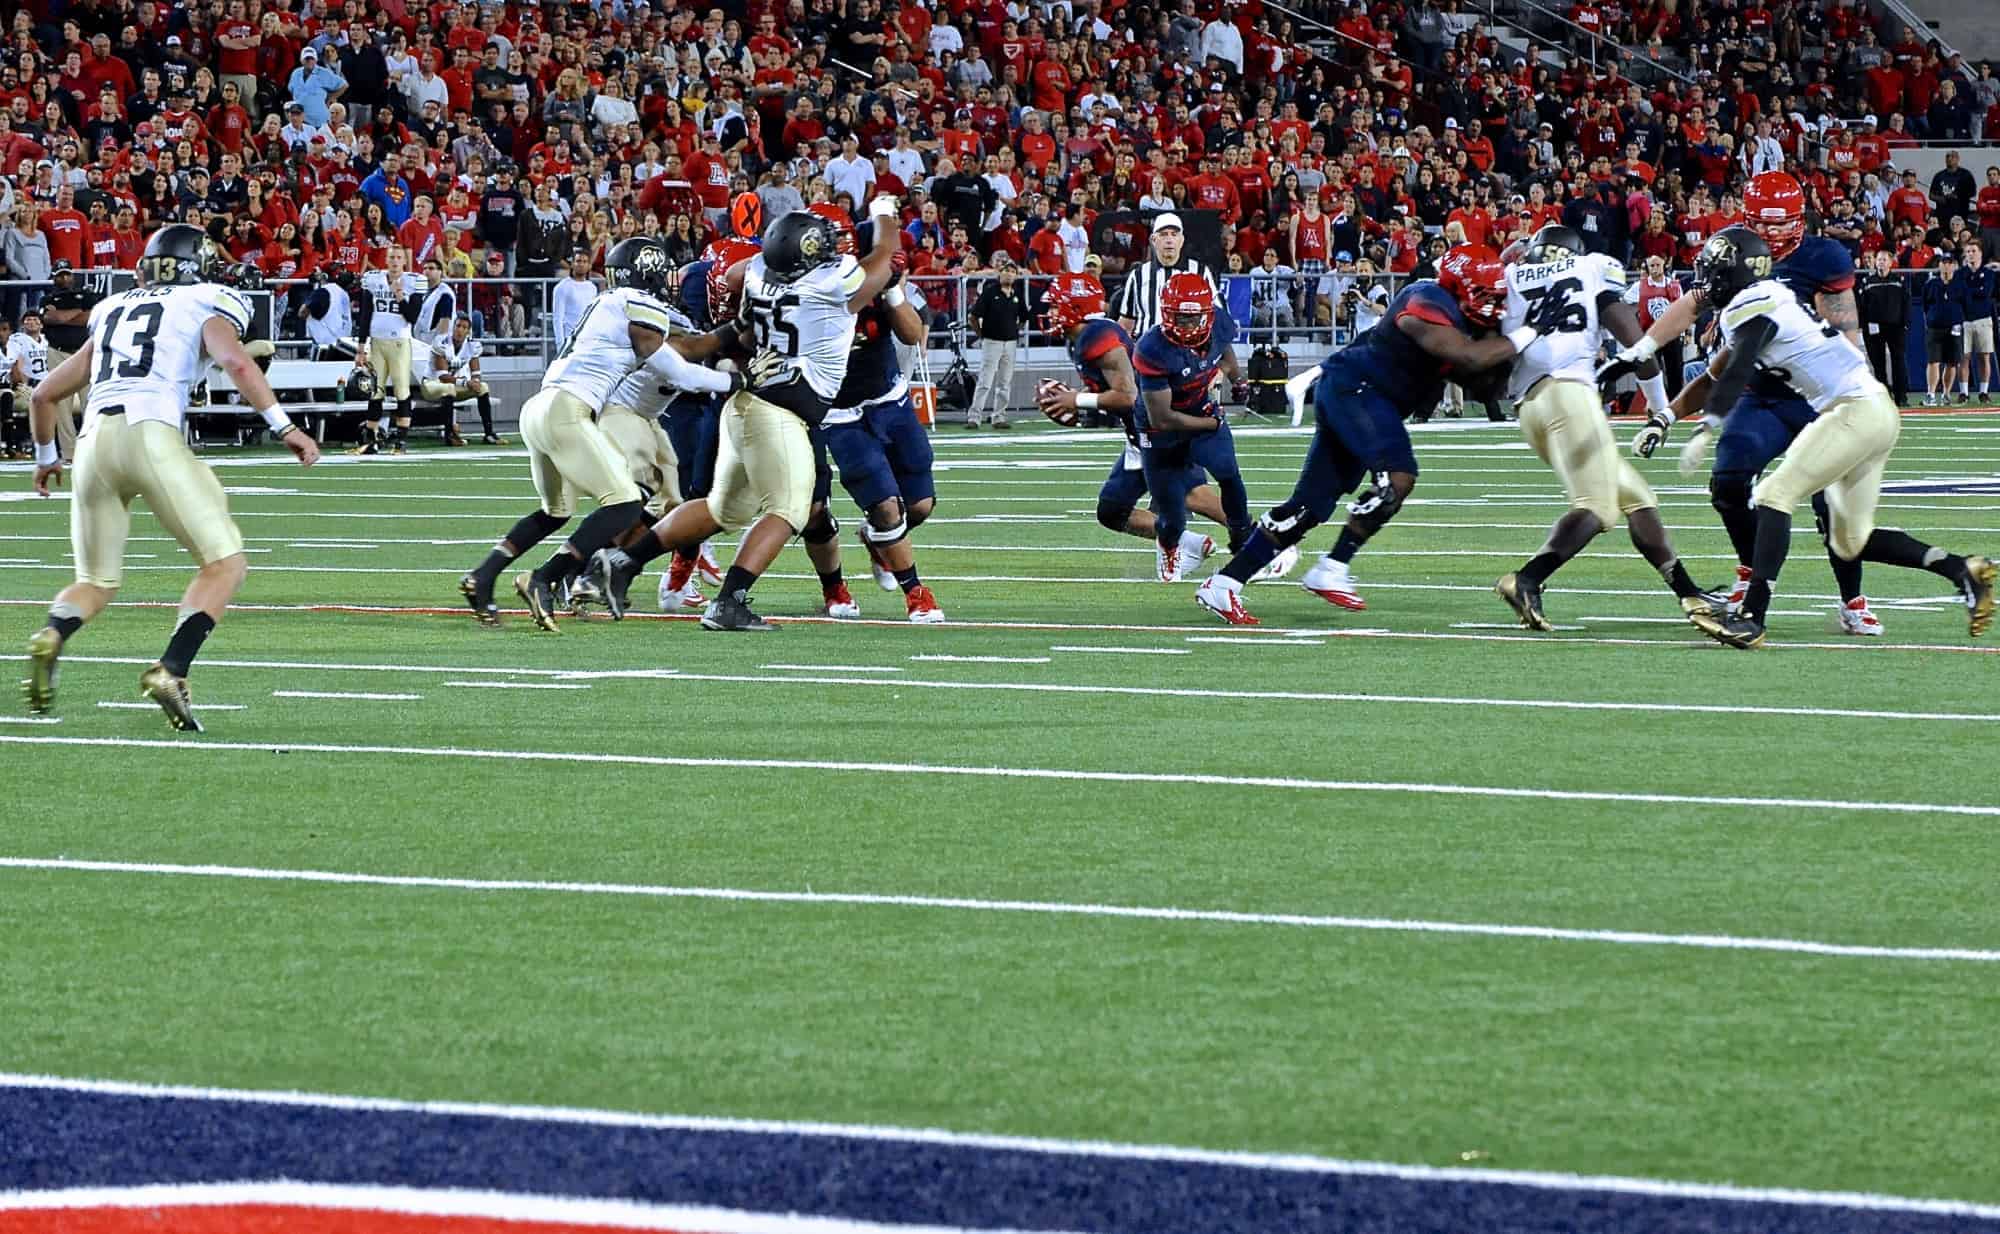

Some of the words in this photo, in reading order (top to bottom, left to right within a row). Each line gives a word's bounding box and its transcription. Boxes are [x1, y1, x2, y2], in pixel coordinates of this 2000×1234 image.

[151, 257, 178, 282] 13
[1515, 257, 1576, 285] PARKER
[752, 294, 801, 357] 55
[95, 302, 165, 381] 13
[912, 391, 924, 410] G
